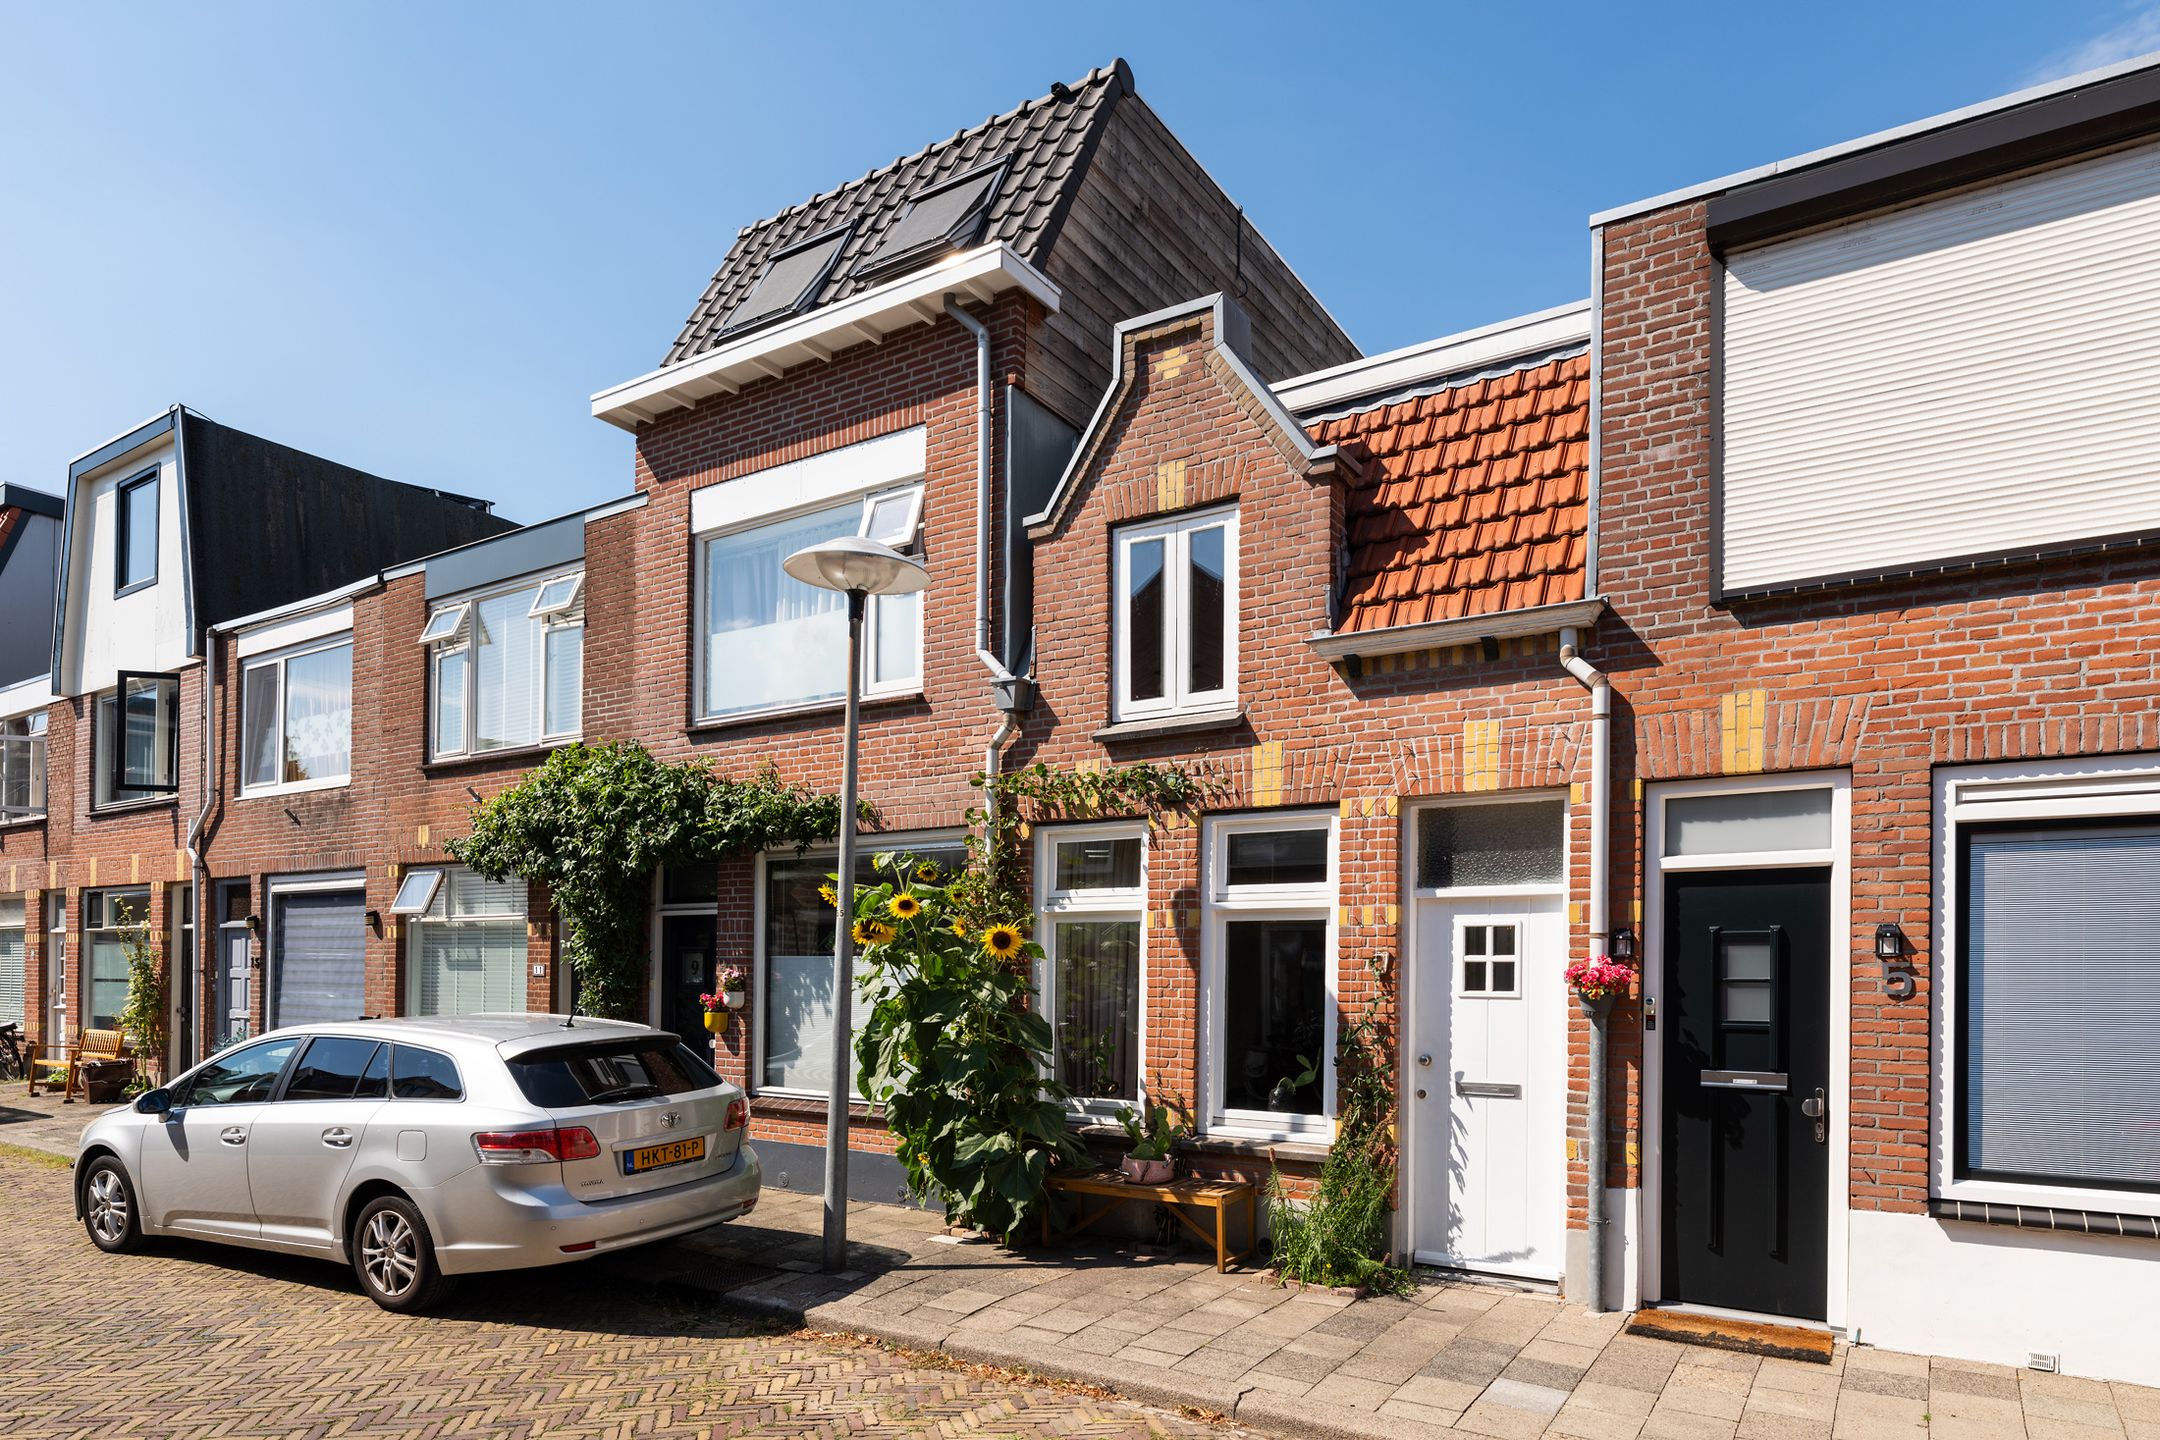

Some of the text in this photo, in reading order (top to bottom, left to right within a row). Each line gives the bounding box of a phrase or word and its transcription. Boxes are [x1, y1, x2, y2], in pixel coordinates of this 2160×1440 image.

[535, 966, 542, 974] 11
[691, 960, 699, 975] 9
[1882, 961, 1912, 995] 5
[641, 1141, 699, 1166] HKT-81-P
